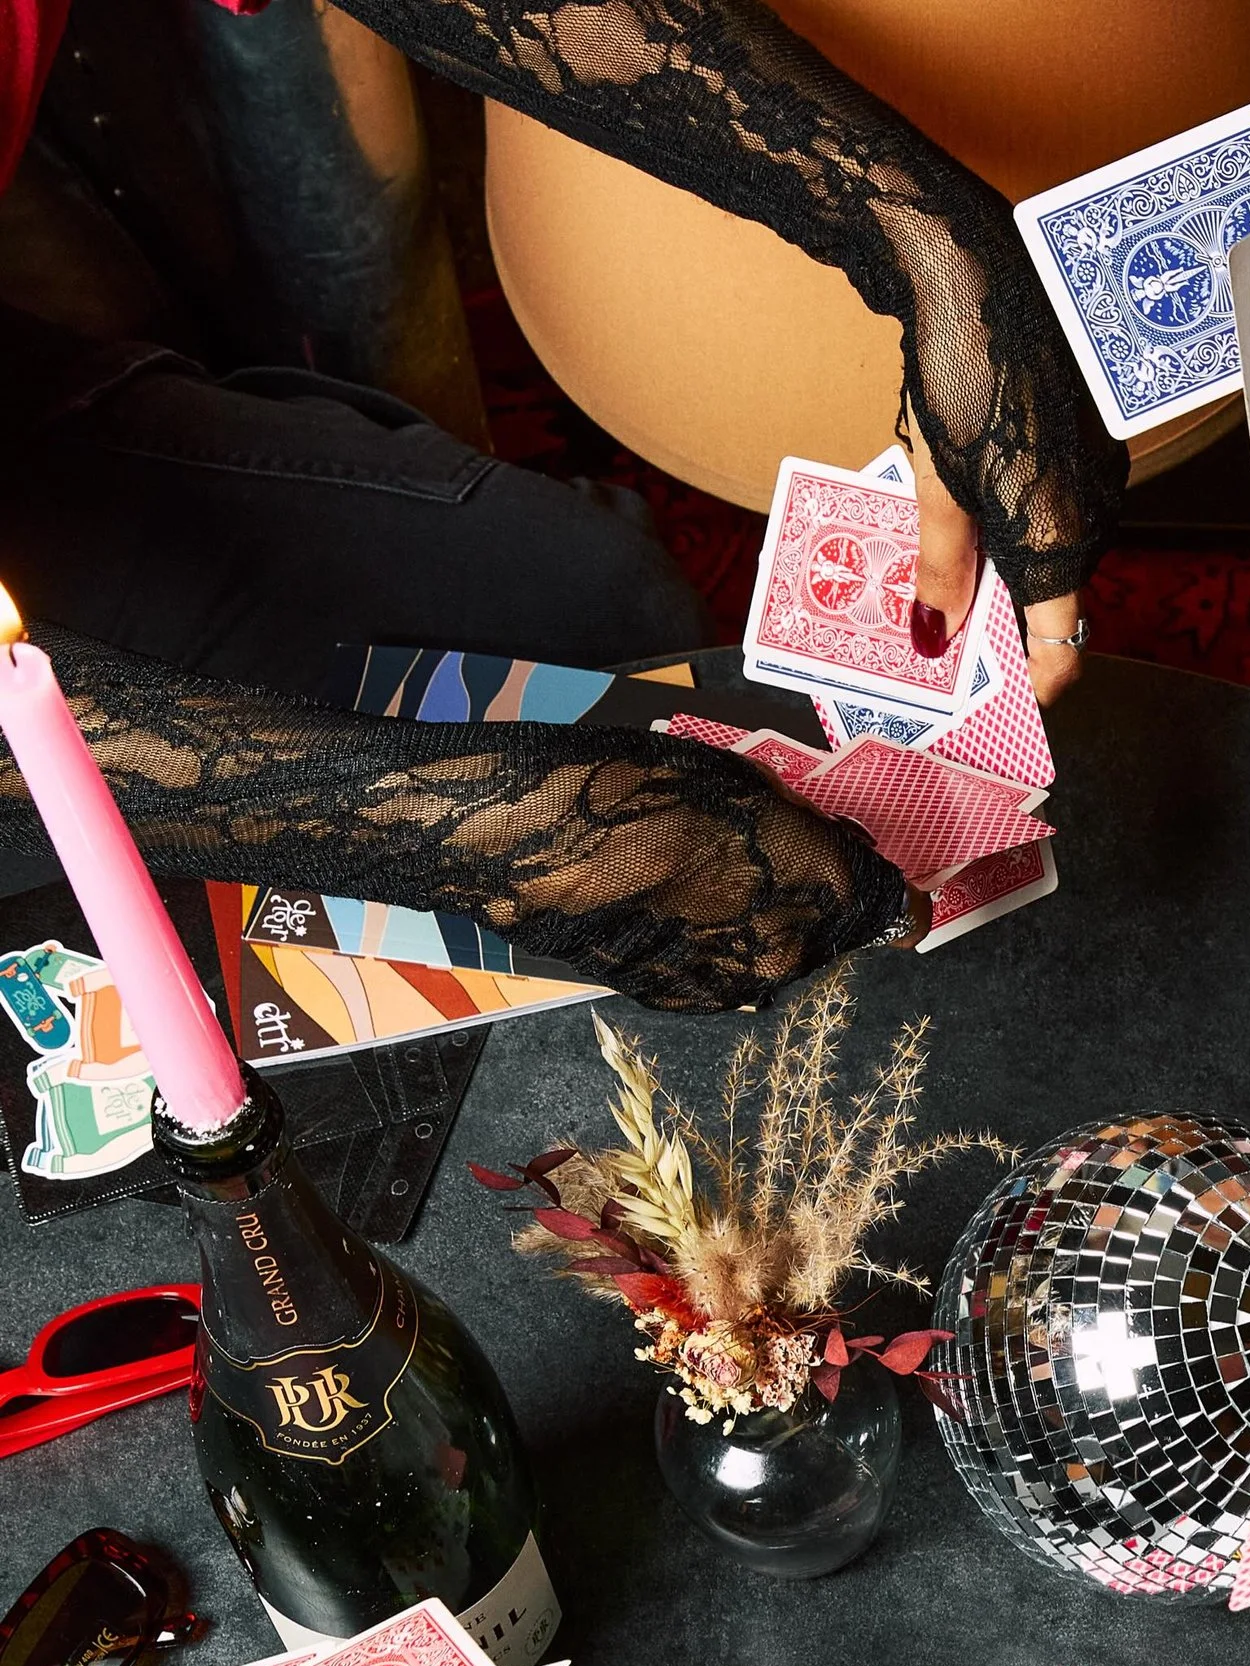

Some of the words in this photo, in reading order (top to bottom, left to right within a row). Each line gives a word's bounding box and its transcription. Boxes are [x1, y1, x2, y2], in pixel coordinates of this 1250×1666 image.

[235, 1212, 268, 1251] CRU
[254, 1255, 298, 1327] GRAND
[276, 1432, 328, 1449] FONDÉE
[331, 1434, 348, 1446] EN
[351, 1412, 372, 1435] 1937
[79, 1648, 94, 1663] 400
